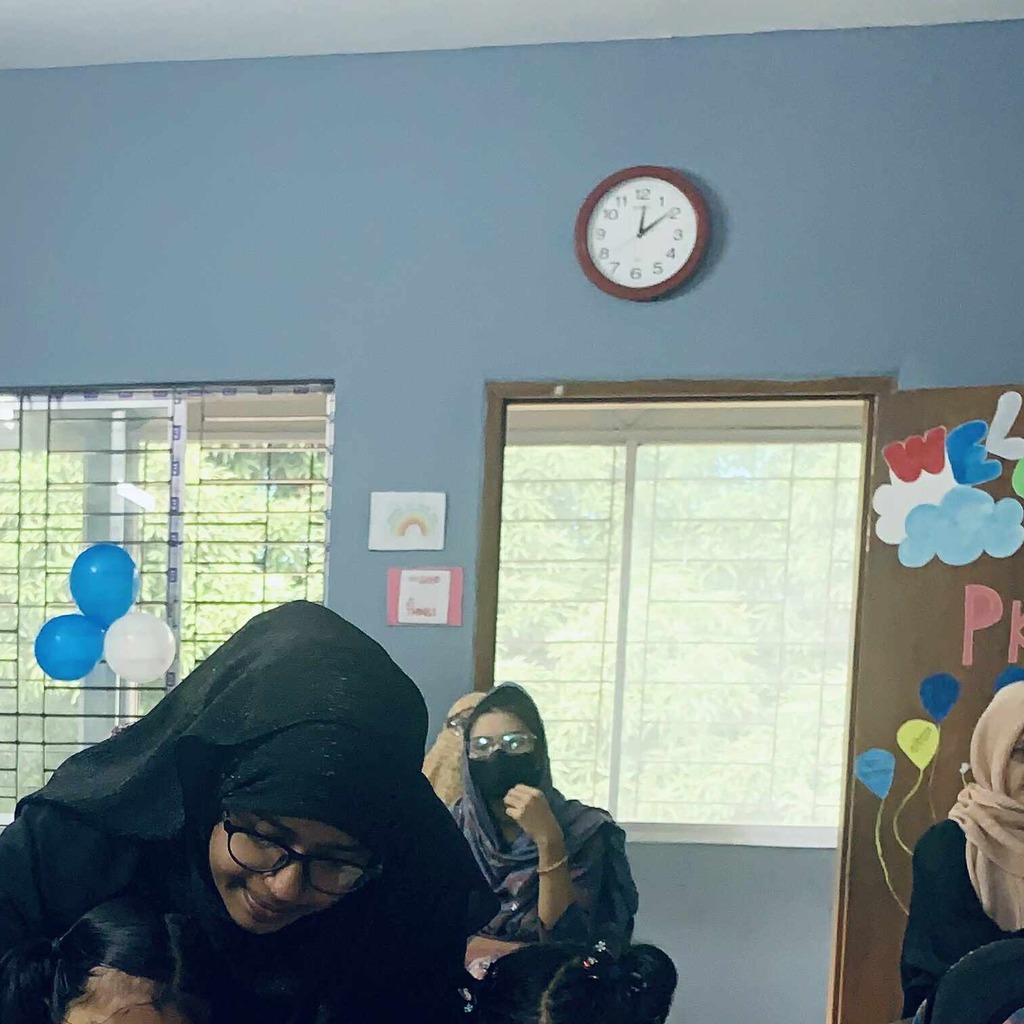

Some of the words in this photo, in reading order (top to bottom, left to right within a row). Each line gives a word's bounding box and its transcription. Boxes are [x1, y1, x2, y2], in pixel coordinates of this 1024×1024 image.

[635, 188, 651, 200] 12
[616, 196, 627, 207] 11
[659, 196, 665, 207] 1
[603, 209, 619, 220] 10
[669, 207, 682, 219] 2
[596, 229, 606, 241] 9
[673, 229, 684, 241] 3
[600, 247, 610, 259] 8
[666, 248, 676, 259] 4
[609, 262, 620, 274] 7
[630, 268, 642, 280] 6
[653, 262, 664, 274] 5
[882, 391, 1024, 497] WEL
